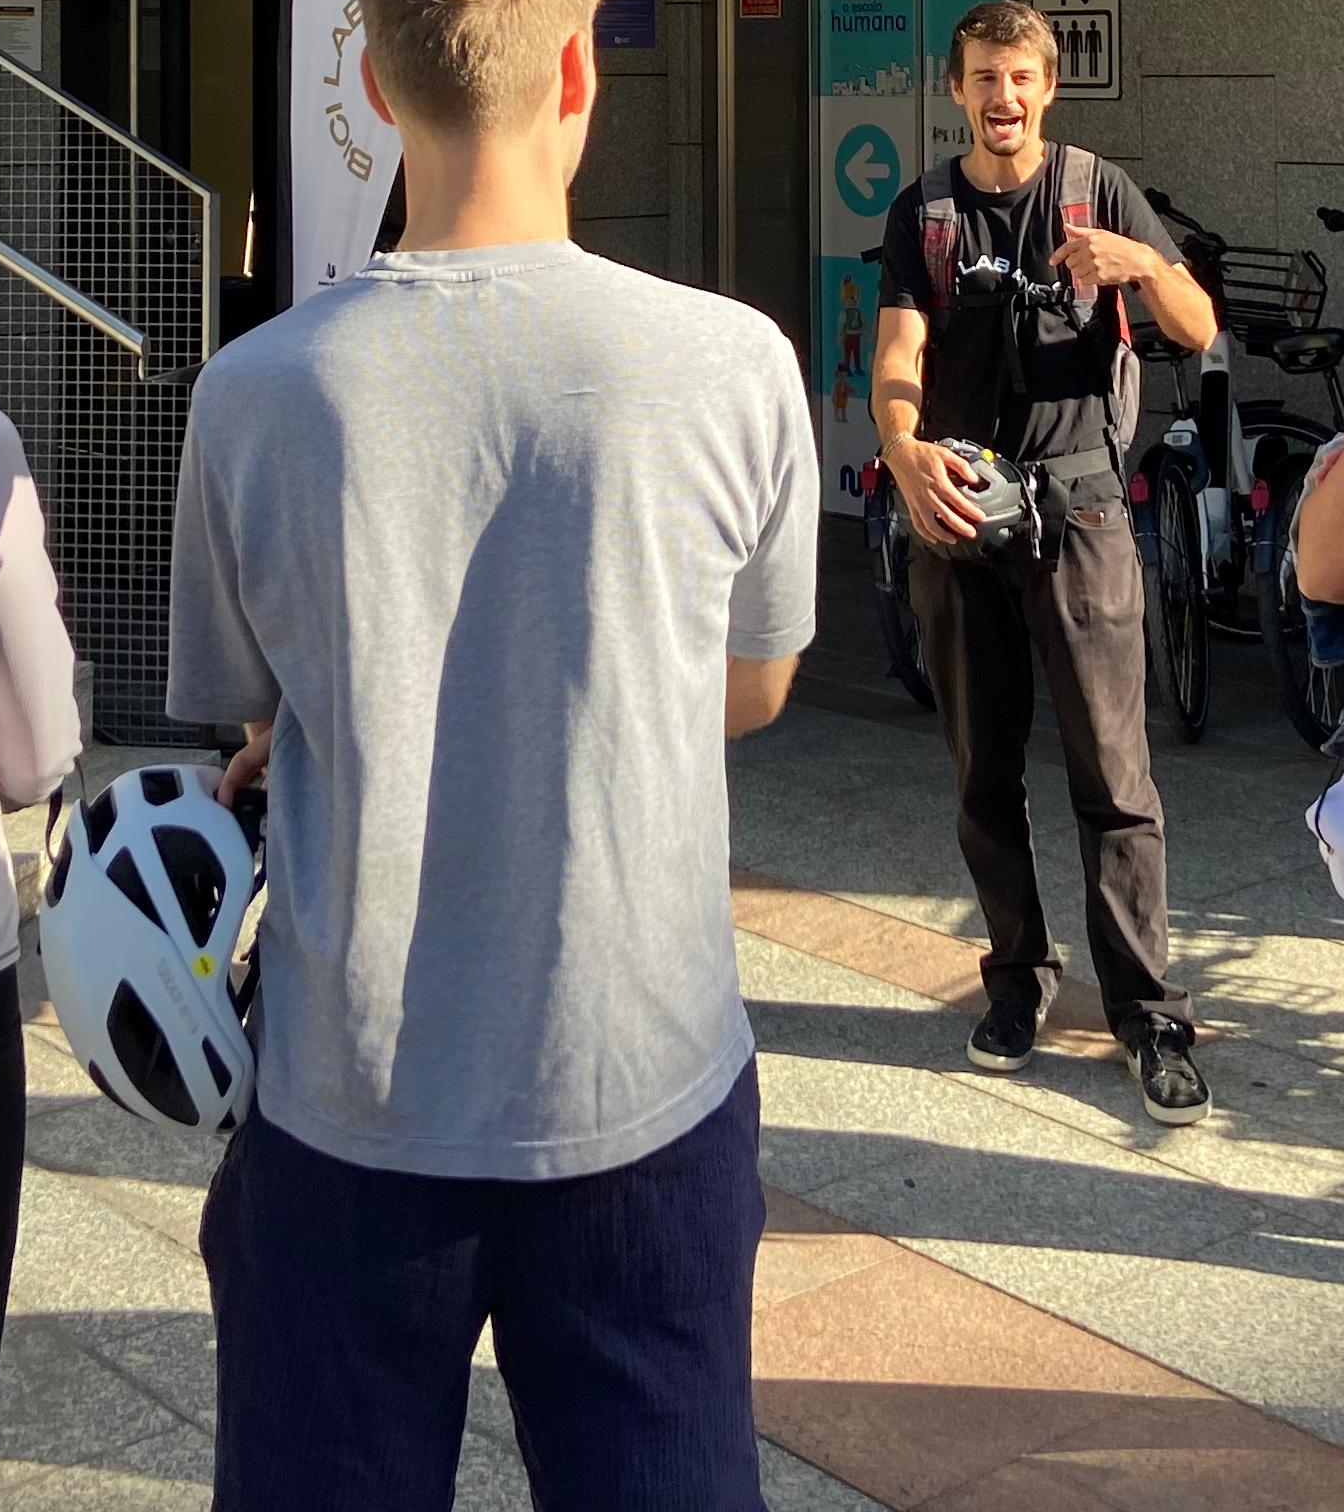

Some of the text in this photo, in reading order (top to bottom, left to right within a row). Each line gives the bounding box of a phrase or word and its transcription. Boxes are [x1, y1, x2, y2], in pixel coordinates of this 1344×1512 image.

[830, 8, 907, 33] humana
[324, 101, 374, 182] BICI
[958, 255, 1011, 275] LAB
